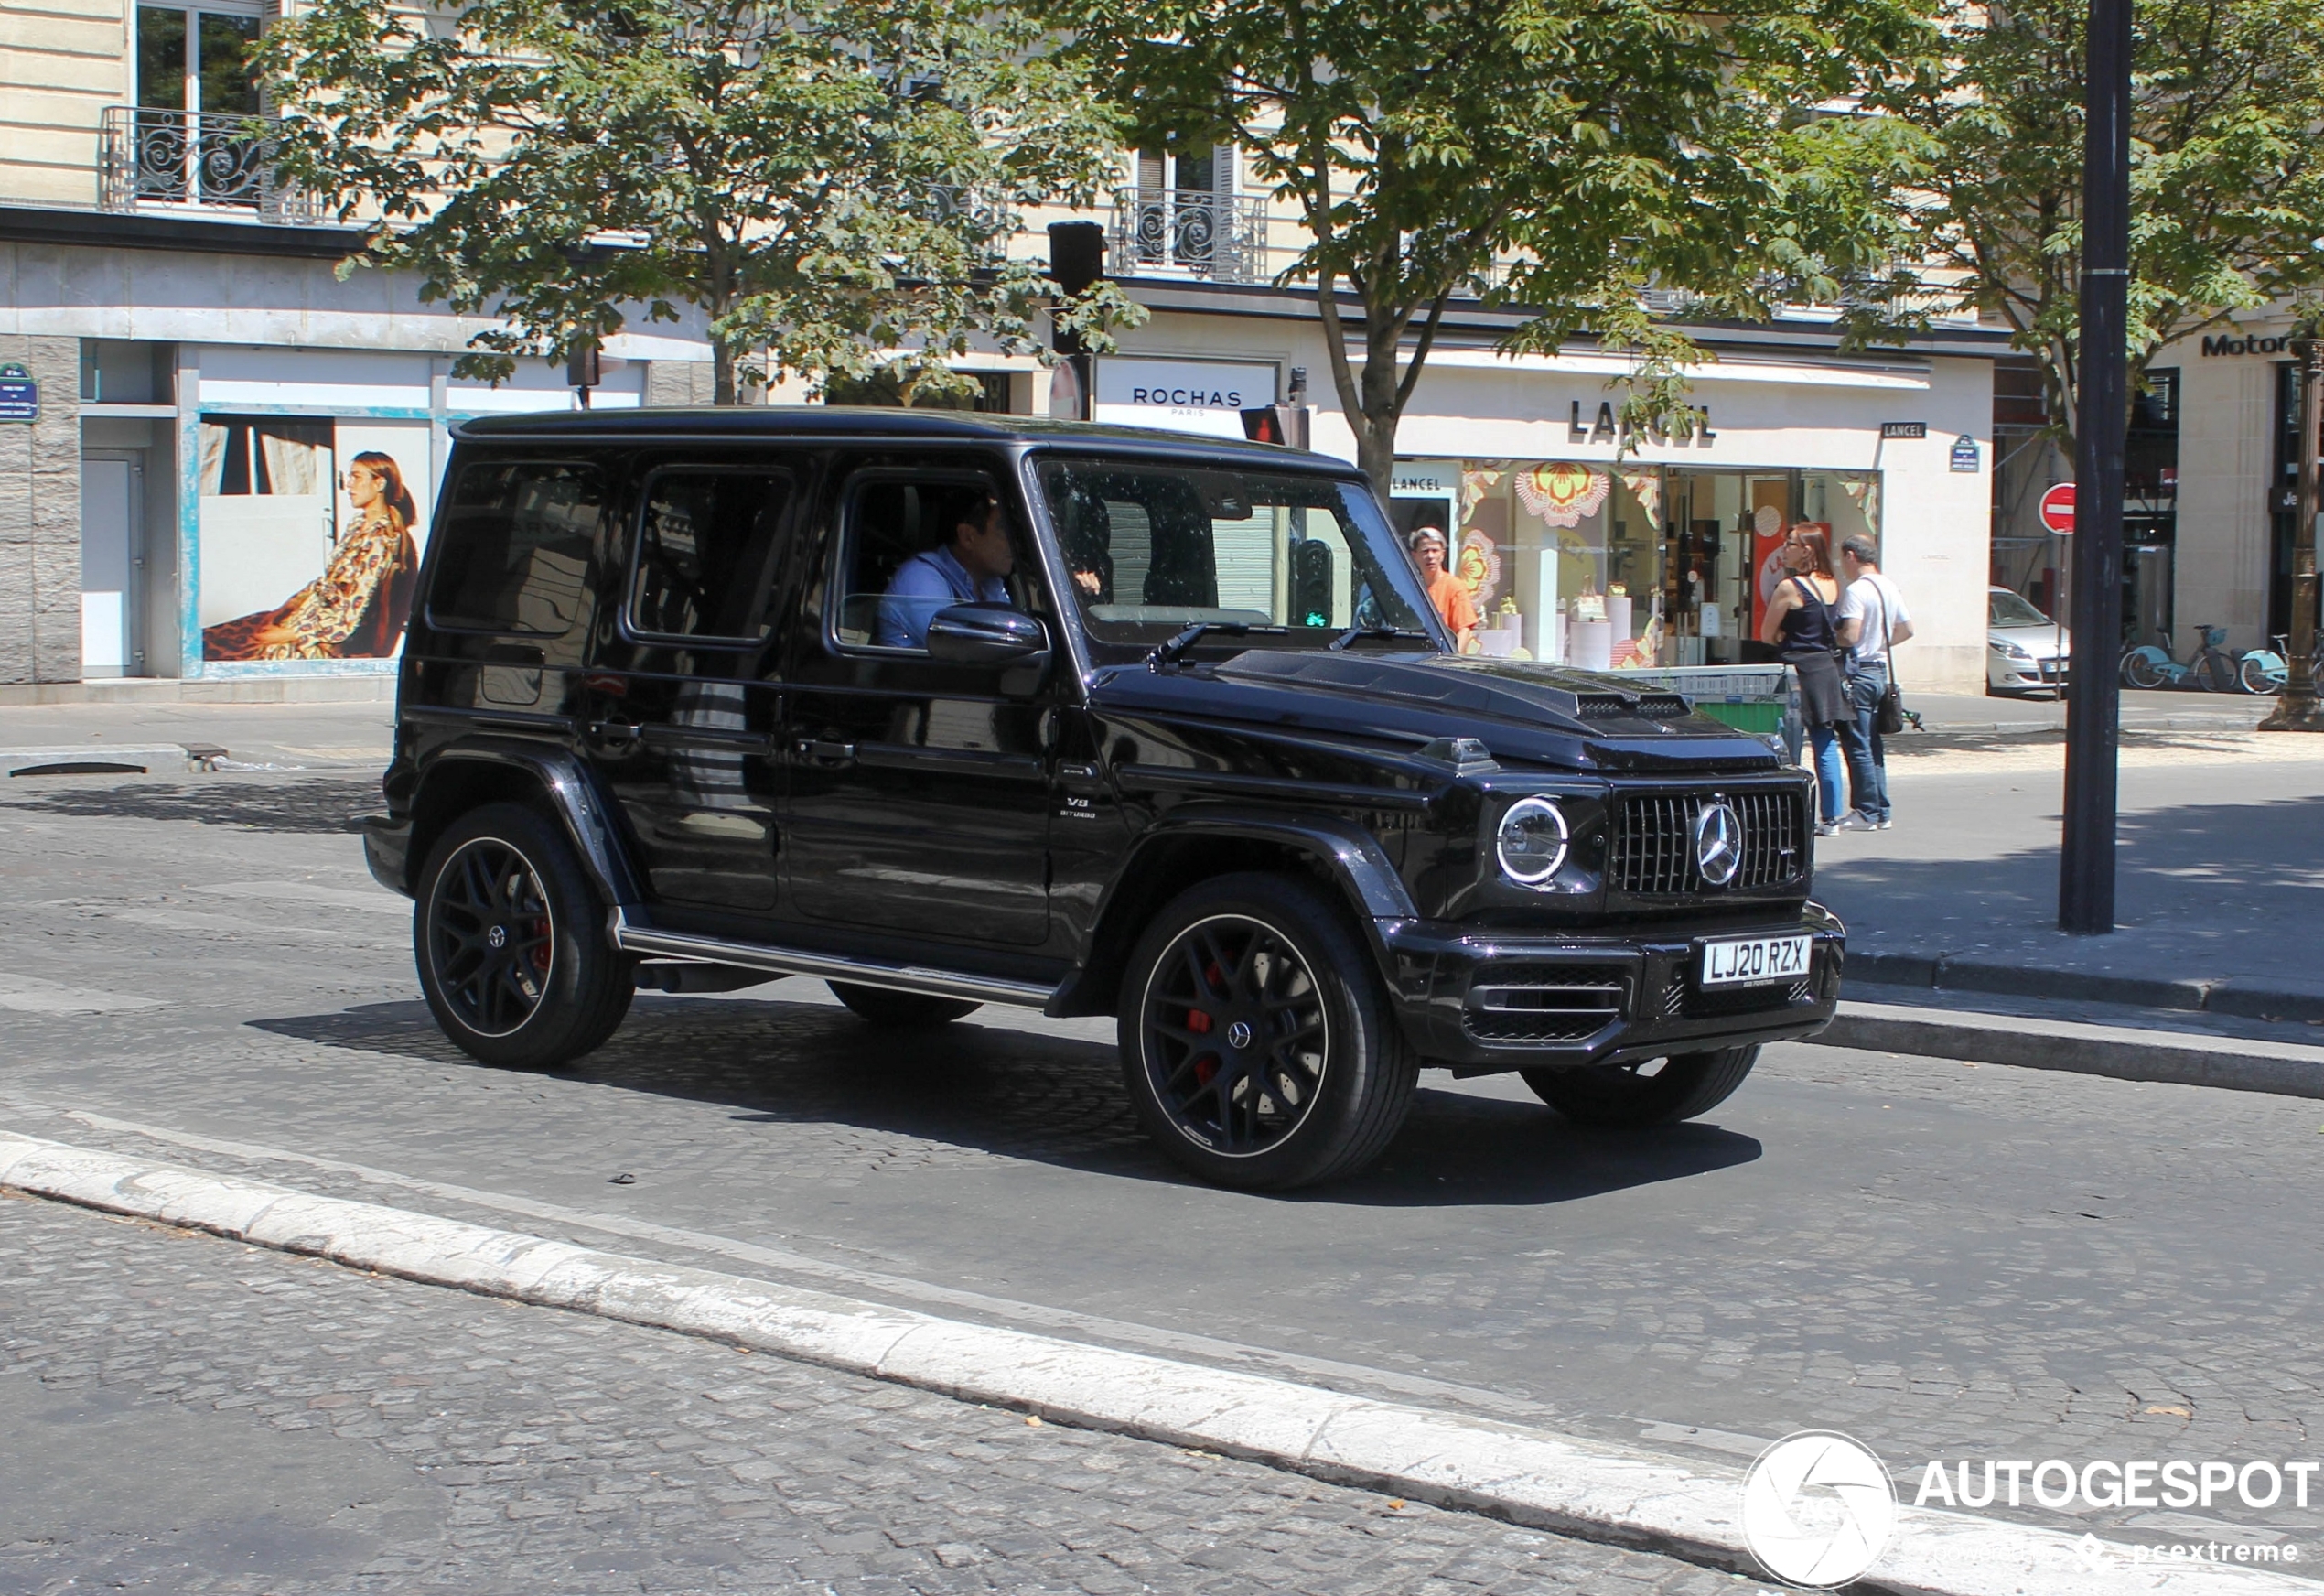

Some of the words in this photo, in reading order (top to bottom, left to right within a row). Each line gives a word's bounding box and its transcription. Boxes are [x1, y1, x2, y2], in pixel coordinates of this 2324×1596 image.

[2201, 333, 2290, 357] Motor
[1133, 387, 1242, 407] ROCHAS
[1171, 408, 1205, 417] PARIS
[1884, 425, 1922, 437] LANCEL
[1392, 477, 1441, 491] LANCEL
[2282, 491, 2297, 506] Je
[1066, 796, 1089, 808] V8
[1060, 810, 1096, 820] BITURBO
[1710, 943, 1763, 979] LJ20
[1768, 939, 1804, 974] RZX
